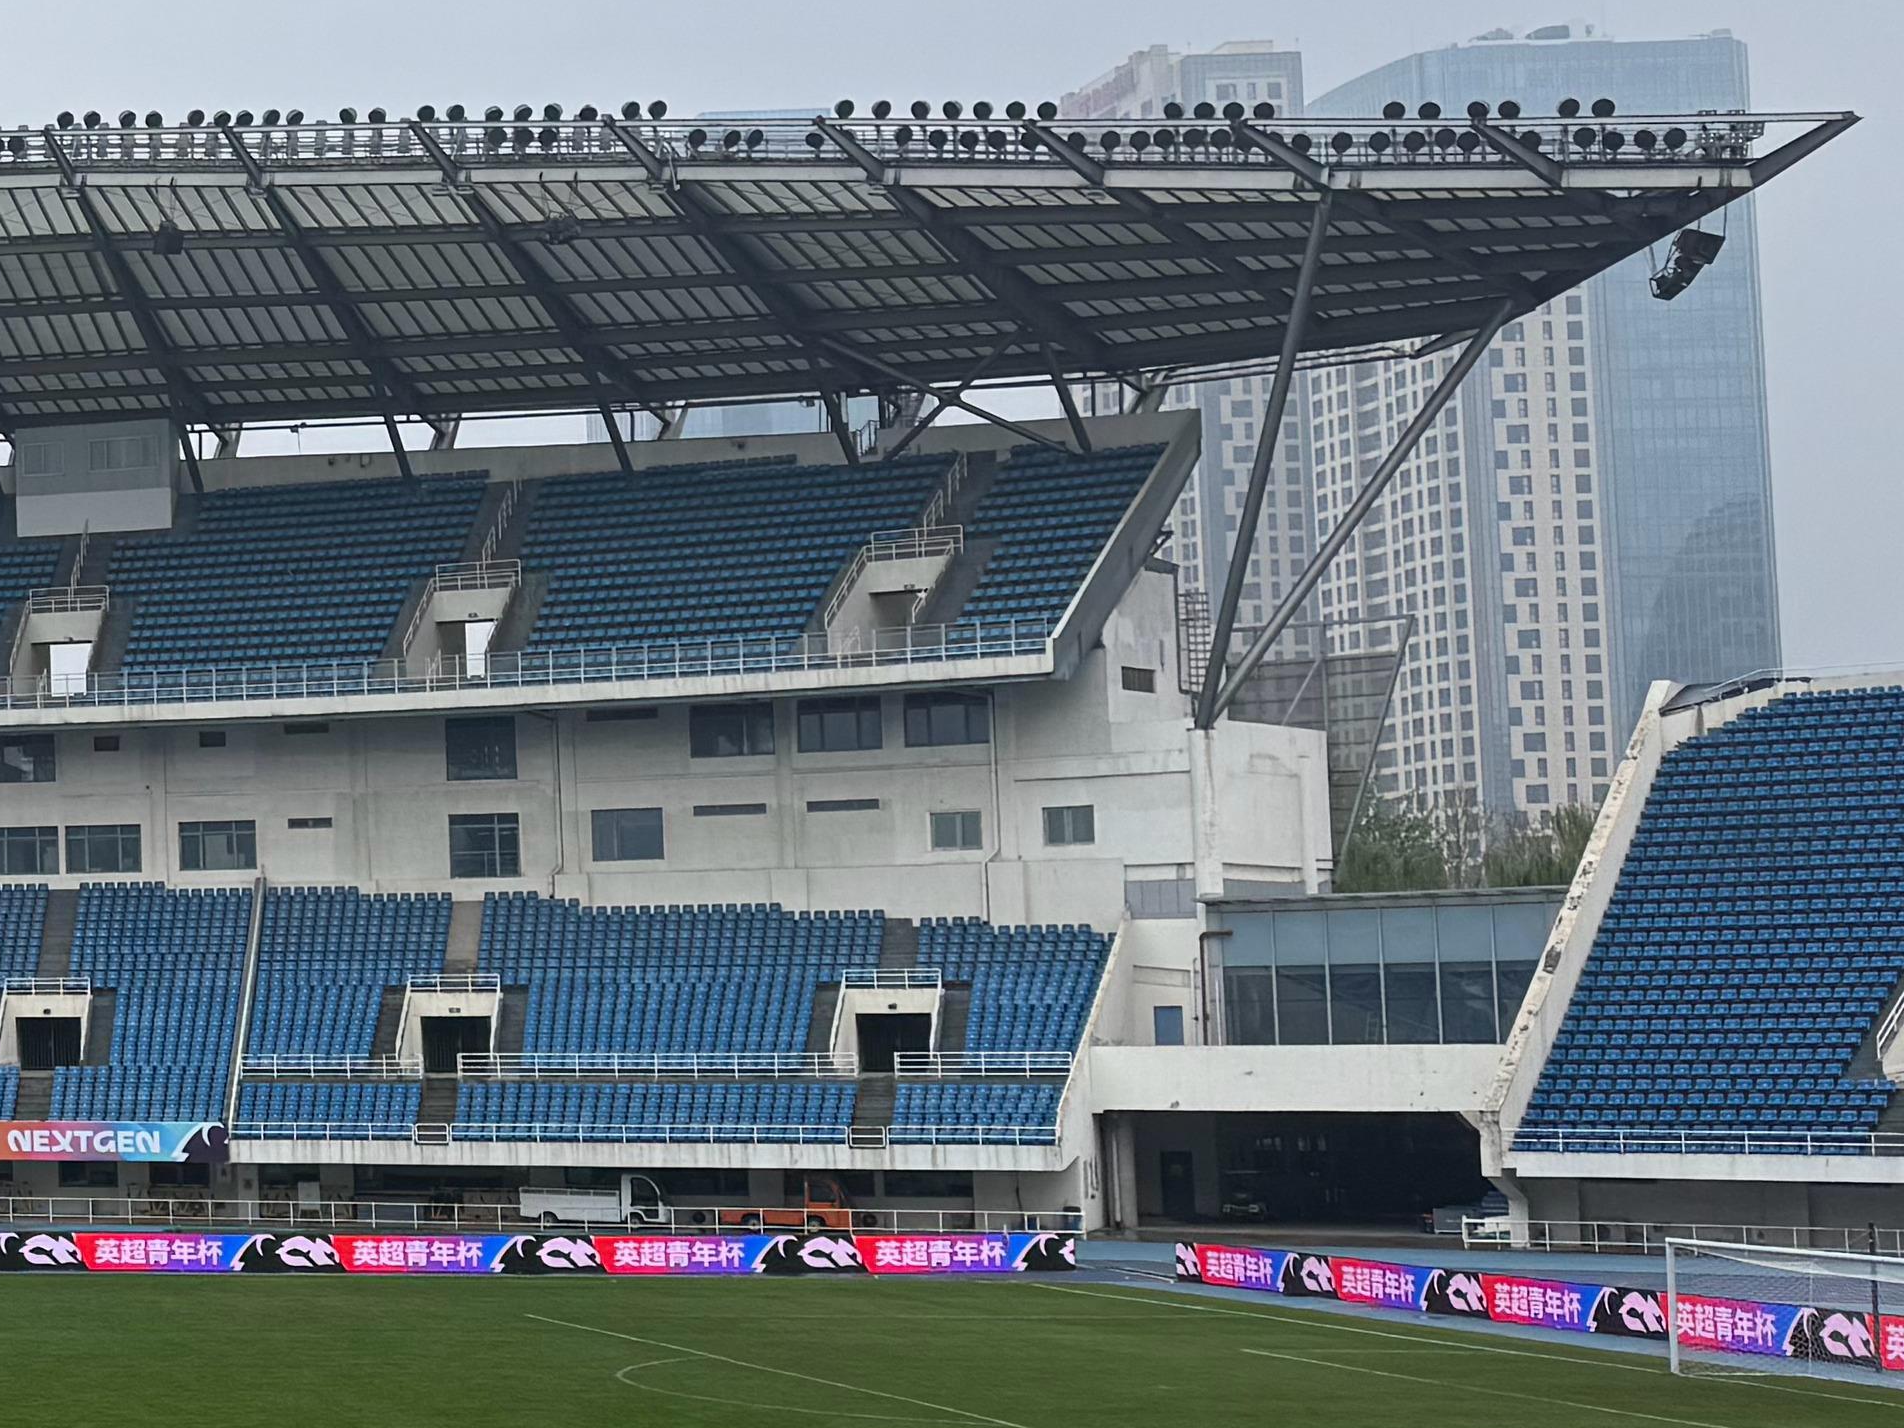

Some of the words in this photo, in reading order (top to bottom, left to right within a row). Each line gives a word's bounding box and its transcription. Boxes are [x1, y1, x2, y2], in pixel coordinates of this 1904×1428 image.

[7, 1129, 161, 1154] NEXTGEN
[94, 1238, 223, 1265] 英超青年杯
[353, 1239, 483, 1266] 英超青年杯
[613, 1240, 745, 1267] 英超青年杯
[874, 1240, 1007, 1267] 英超青年杯
[1206, 1250, 1274, 1284] 英超青年杯
[1341, 1265, 1415, 1302] 英超青年杯
[1493, 1283, 1581, 1323] 英超青年杯
[1675, 1302, 1777, 1347] 英超青年杯
